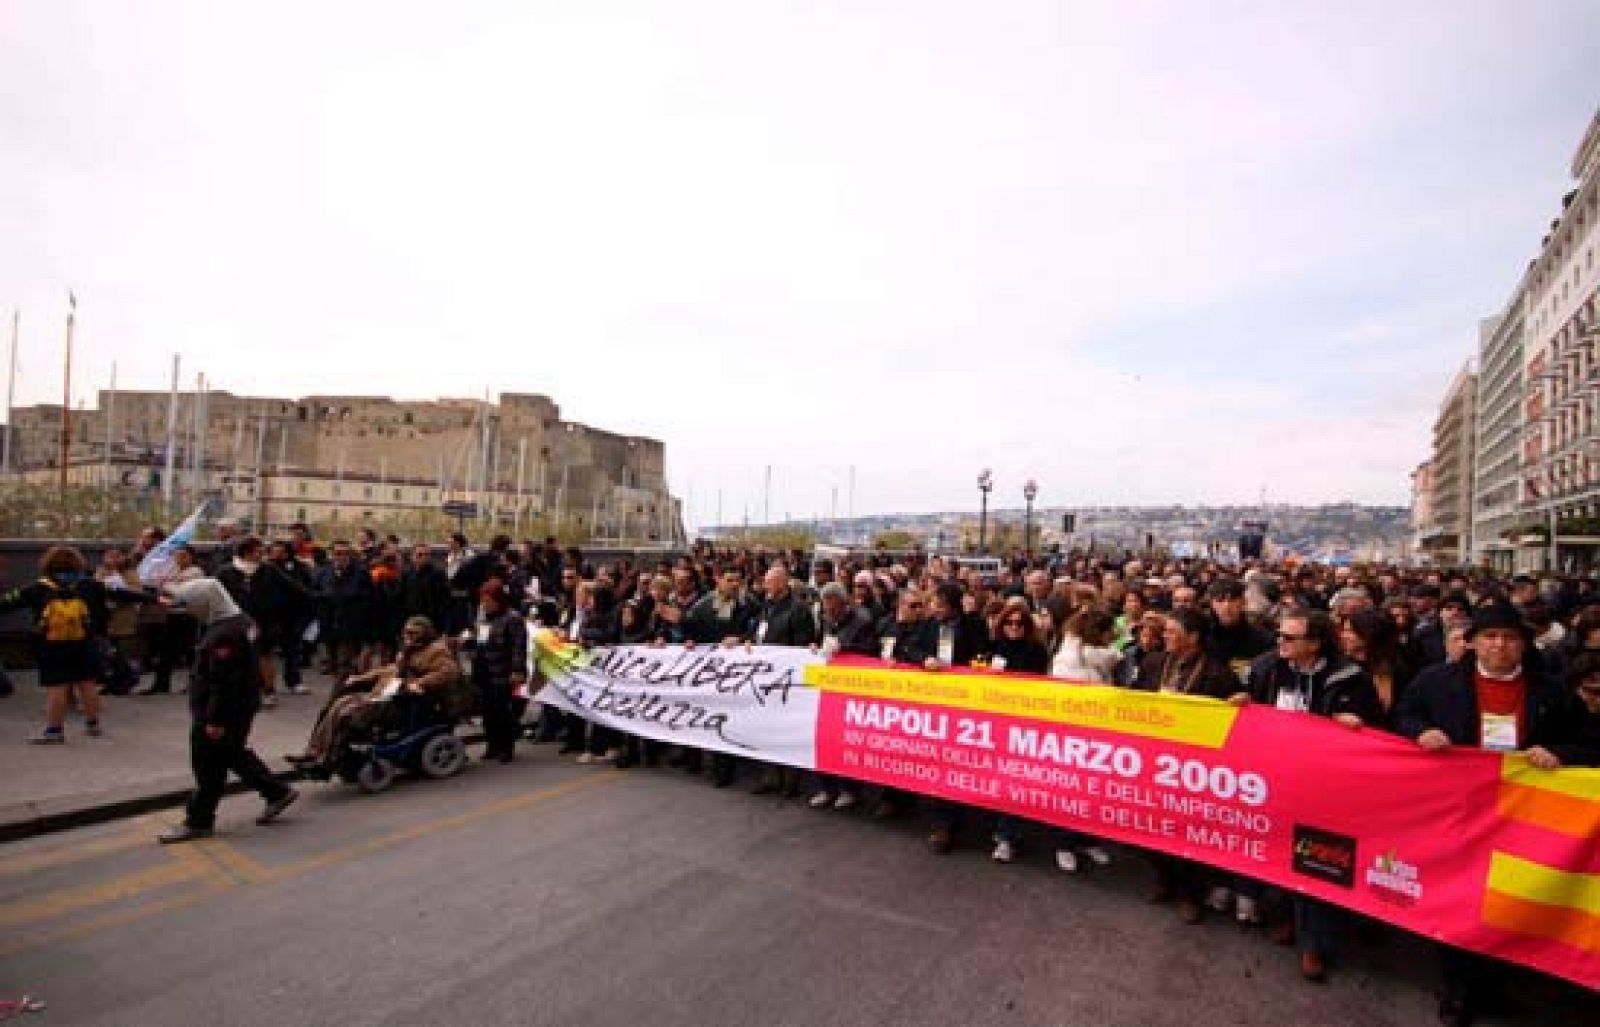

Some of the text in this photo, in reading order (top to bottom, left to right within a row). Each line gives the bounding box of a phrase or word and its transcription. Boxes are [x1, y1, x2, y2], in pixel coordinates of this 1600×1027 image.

[843, 750, 859, 766] IN
[863, 754, 940, 785] RICORDO
[946, 770, 1001, 798] DELLE
[1009, 784, 1091, 820] VITTIME
[1102, 804, 1176, 836] DELLE
[1186, 824, 1267, 863] MAFIE
[845, 700, 1268, 807] NAPOLI 21 MARZO 2009
[867, 733, 938, 761] GIORNATA
[942, 746, 993, 770] DELLA
[998, 757, 1080, 792] MEMORIA
[1087, 776, 1100, 796] E
[1105, 780, 1270, 834] DELL'IMPEGNO
